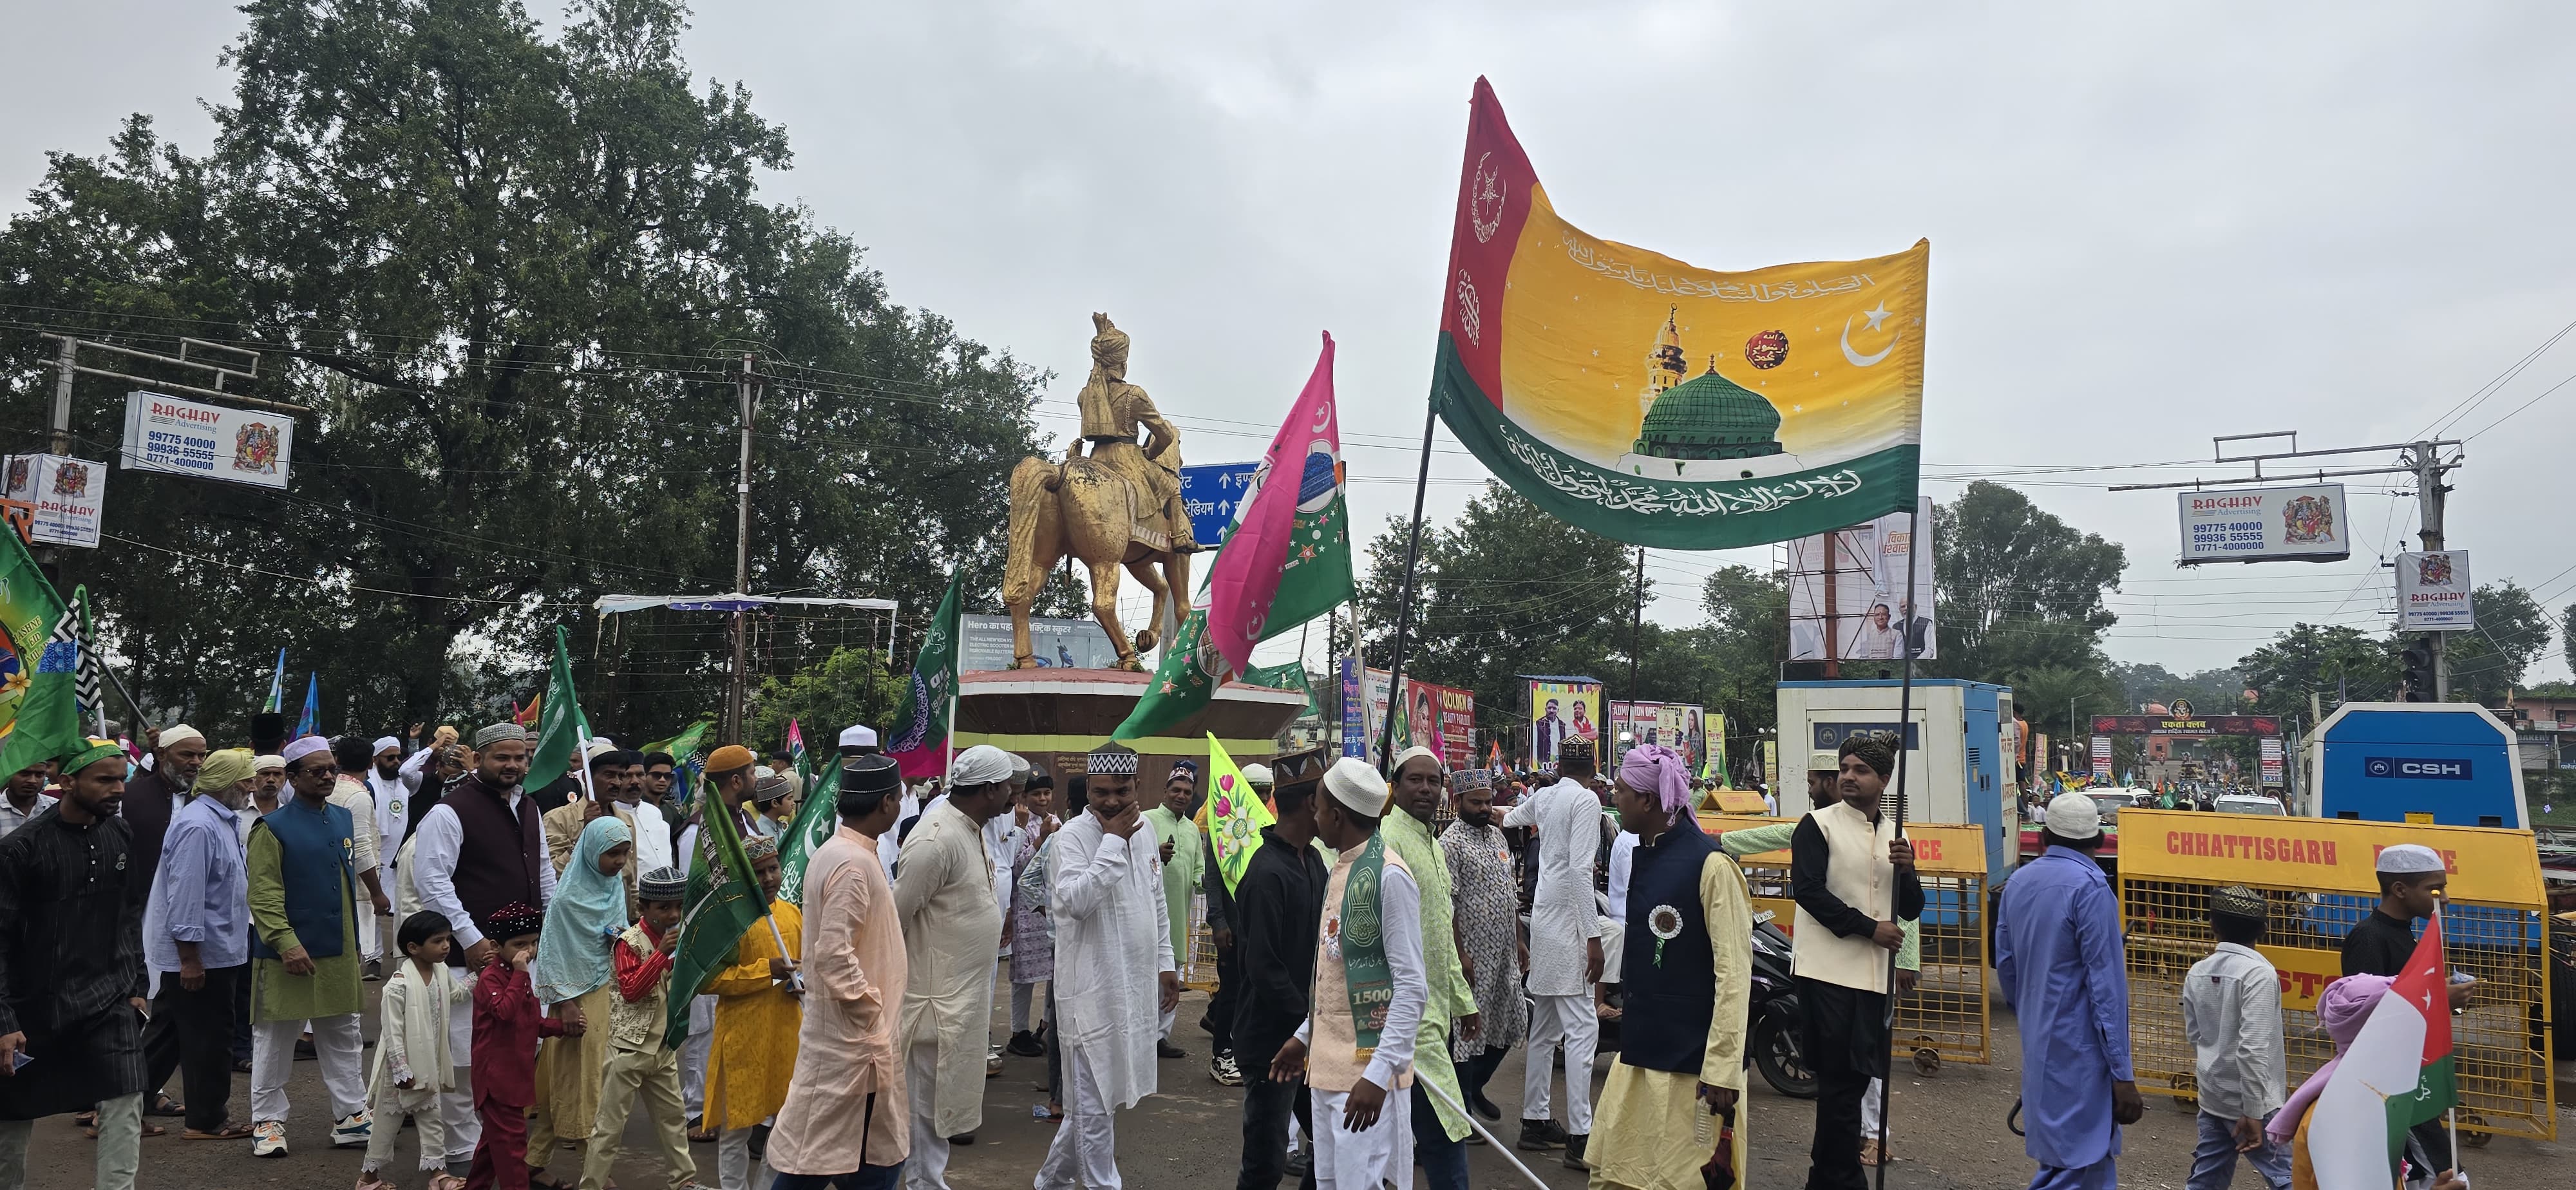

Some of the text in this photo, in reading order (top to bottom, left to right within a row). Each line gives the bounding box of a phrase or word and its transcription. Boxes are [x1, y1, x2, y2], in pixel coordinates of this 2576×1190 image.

[151, 402, 220, 424] RAGHAV
[175, 419, 217, 433] Advertising
[148, 431, 216, 449] 99775 40000
[147, 442, 214, 460] 99936 55555
[147, 453, 214, 470] 0771-4000000
[40, 500, 95, 516] RAGHAV
[2191, 495, 2262, 510] RAGHAV
[2217, 507, 2262, 516] Advertising
[2193, 521, 2262, 533] 99775 40000
[2193, 532, 2263, 543] 99936 55555
[2194, 542, 2264, 552] 0771-4000000
[2410, 592, 2465, 602] RAGHAV
[14, 616, 42, 643] JASHNE
[968, 619, 987, 630] Hero
[989, 621, 999, 630] का
[28, 631, 41, 647] EID
[1443, 689, 1467, 712] GOLDEN
[1613, 704, 1645, 717] ADMIION
[2402, 762, 2461, 775] CSH
[2166, 830, 2338, 867] CHHATTISGARH
[1352, 988, 1392, 1005] 1500
